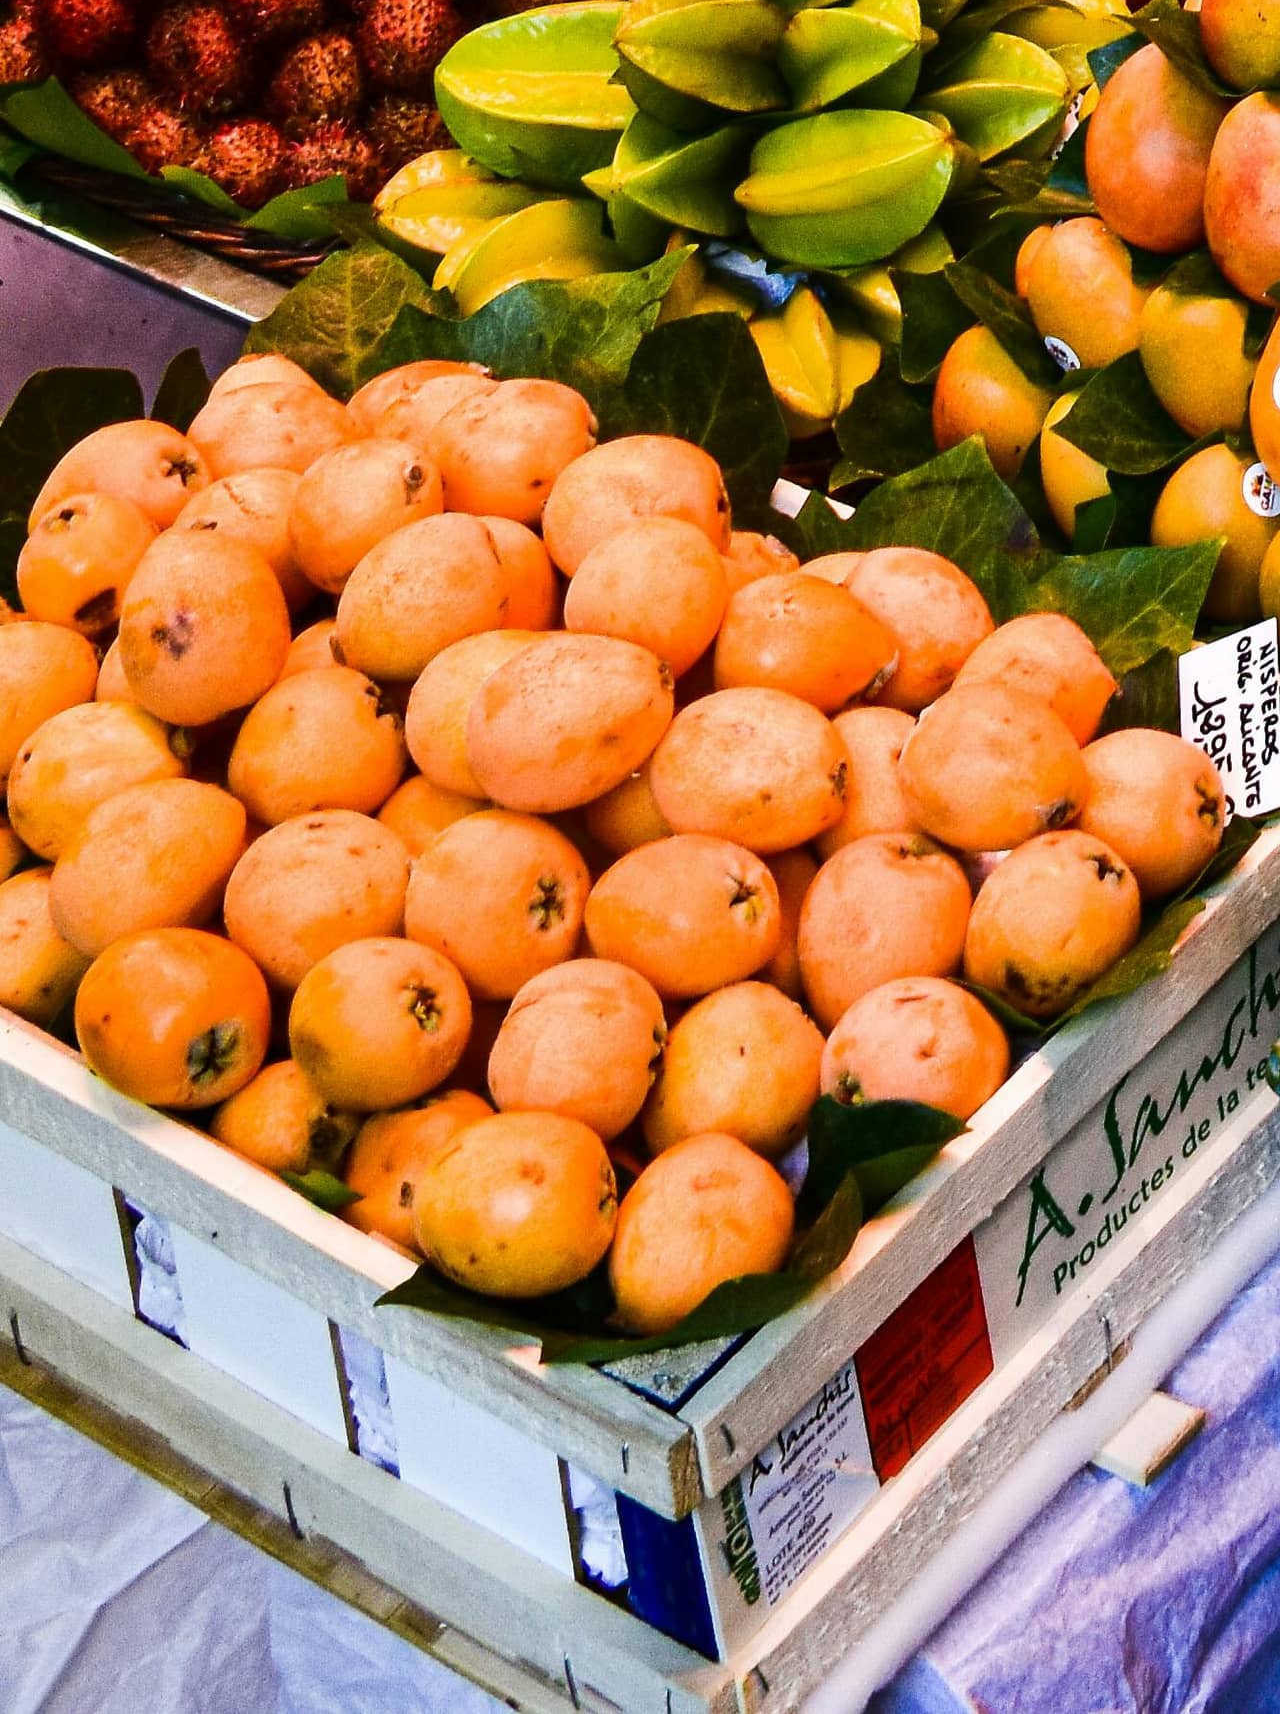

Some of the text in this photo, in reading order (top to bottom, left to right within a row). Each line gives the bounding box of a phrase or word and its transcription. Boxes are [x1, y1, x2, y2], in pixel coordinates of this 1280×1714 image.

[1237, 702, 1262, 809] ALICANTE
[1258, 640, 1280, 766] NISPEROS
[1053, 1155, 1176, 1297] Productes
[1181, 1117, 1213, 1163] de
[1216, 1086, 1241, 1125] la
[764, 1537, 794, 1577] LOTE
